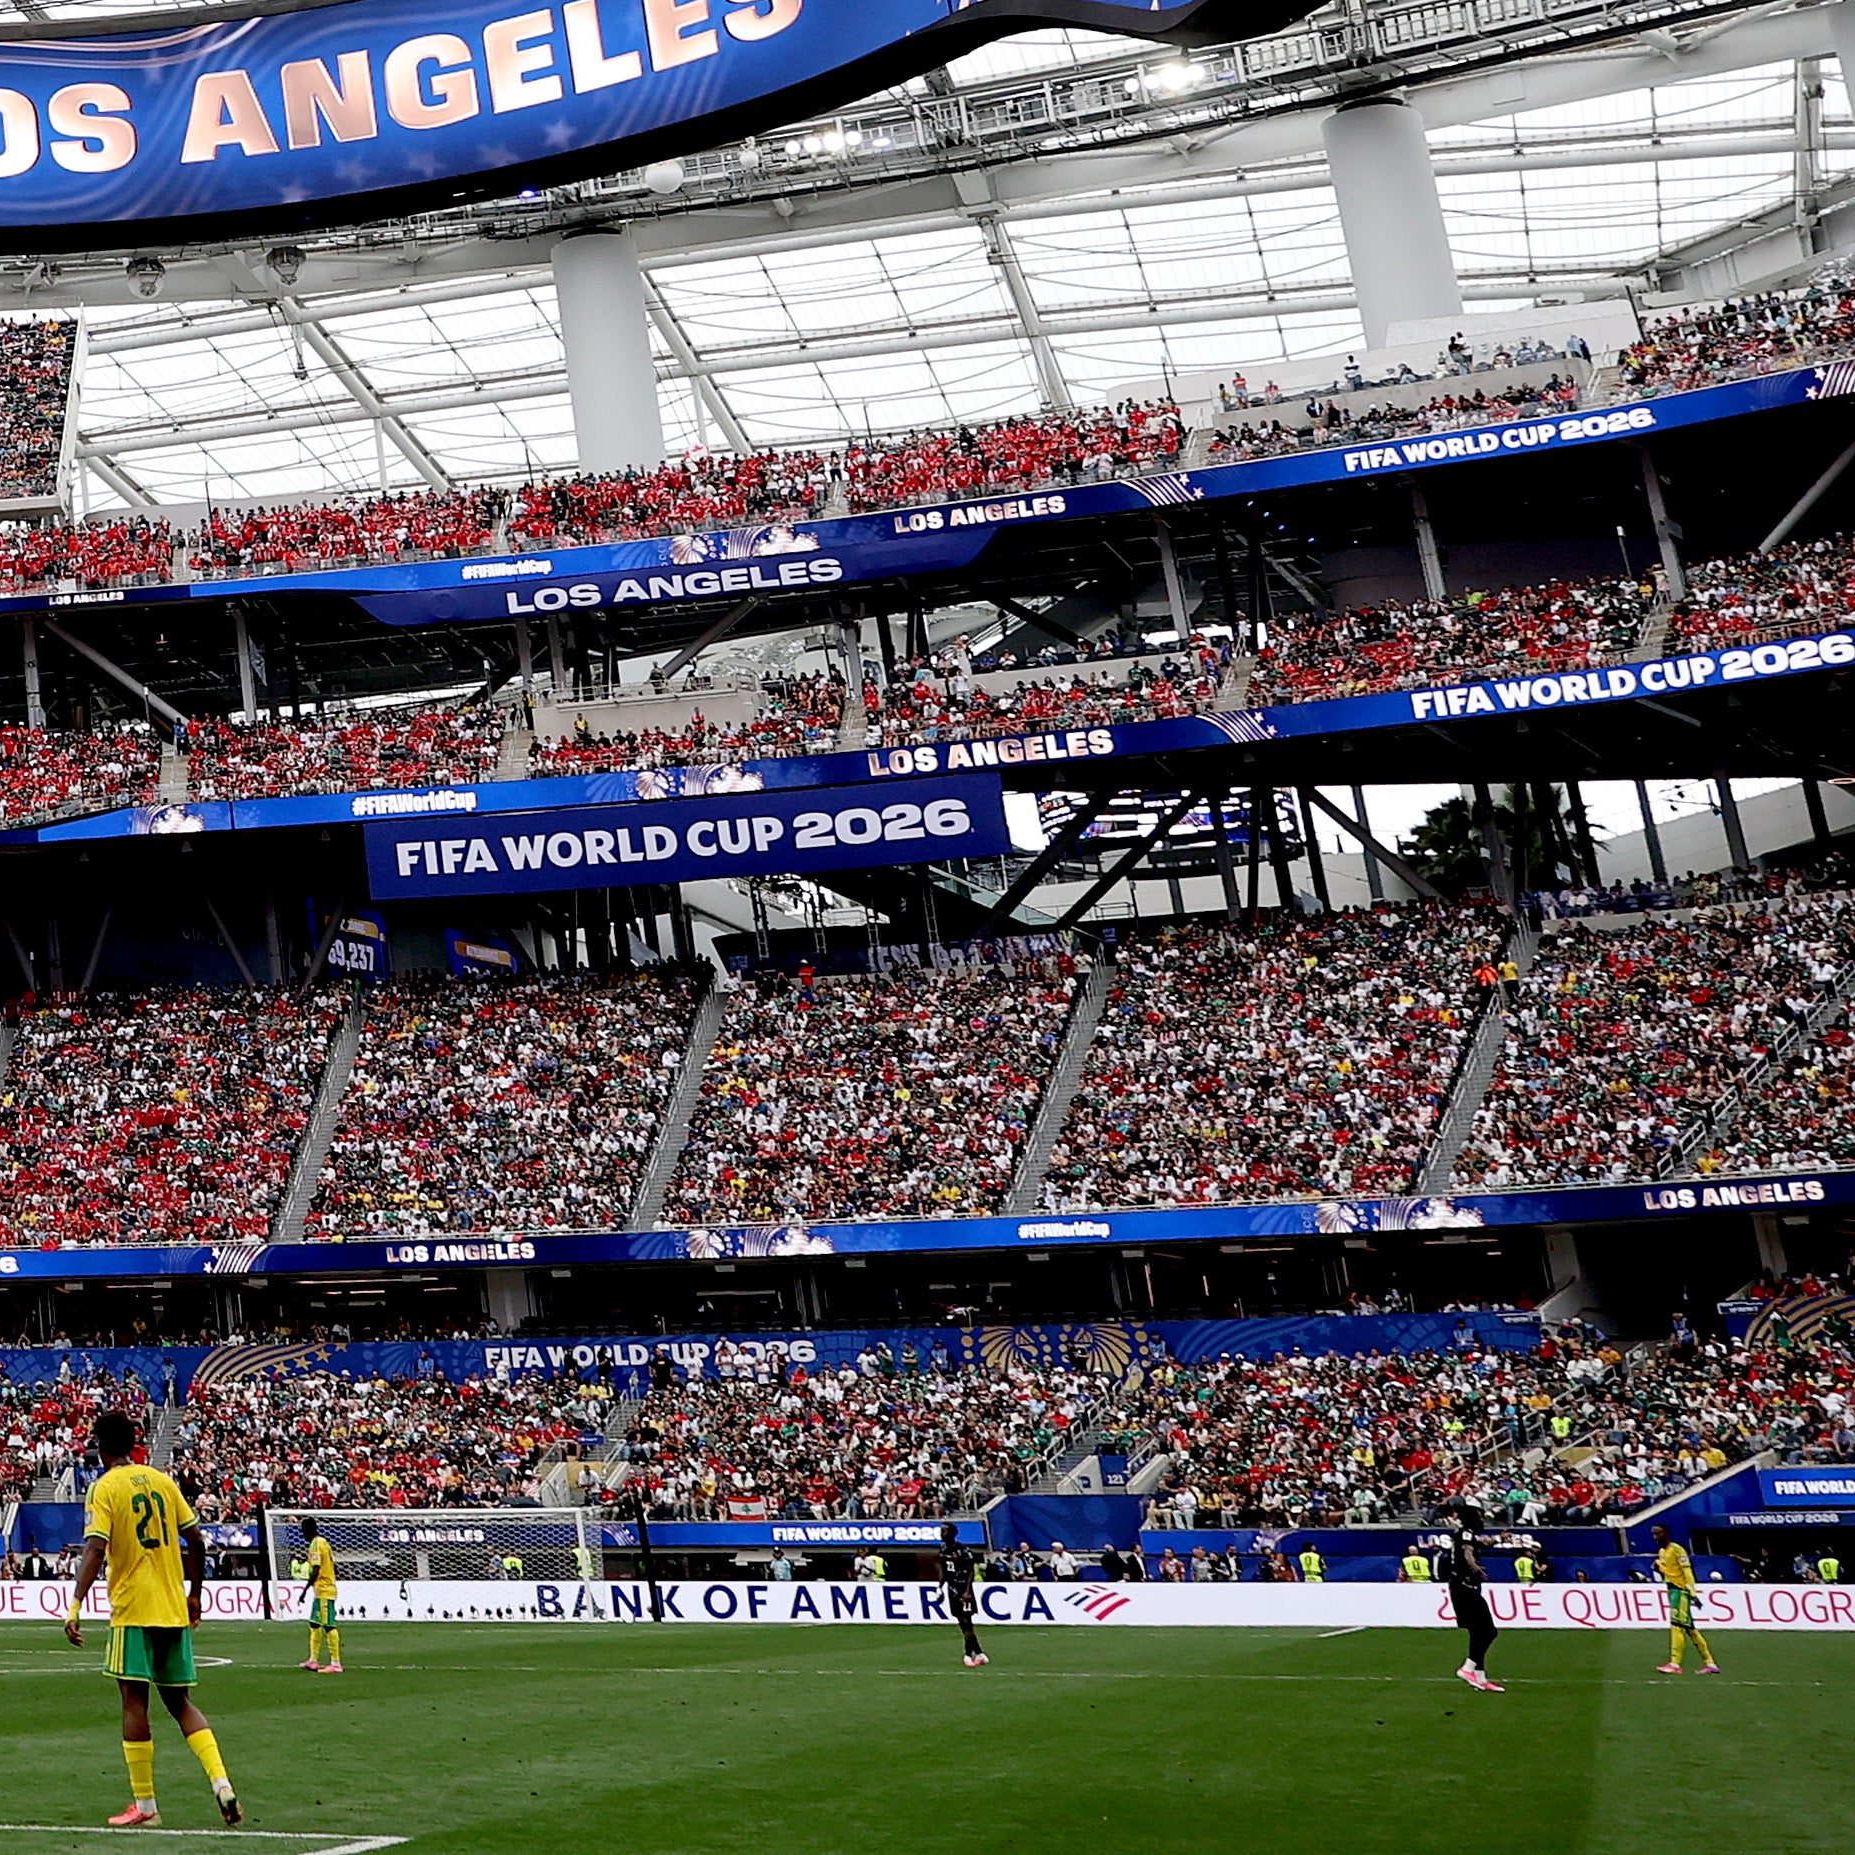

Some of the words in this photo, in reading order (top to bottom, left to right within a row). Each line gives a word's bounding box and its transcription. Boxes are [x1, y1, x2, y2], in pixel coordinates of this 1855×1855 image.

[1345, 448, 1402, 471] FIFA
[1402, 433, 1499, 462] WORLD
[1502, 424, 1556, 448] CUP
[1559, 408, 1654, 440] 2026
[895, 511, 943, 533] LOS
[950, 496, 1065, 526] ANGELES
[49, 595, 71, 605] LOS
[73, 592, 124, 603] ANGELES
[507, 584, 601, 613] LOS
[614, 559, 842, 602] ANGELES
[1411, 686, 1494, 718] FIFA
[1494, 670, 1636, 710] WORLD
[1641, 657, 1715, 690] CUP
[1720, 635, 1855, 679] 2026
[868, 747, 938, 776] LOS
[948, 729, 1113, 769] ANGELES
[352, 790, 476, 815] #FIFAWorldCup
[396, 839, 498, 876] FIFA
[502, 826, 677, 870] WORLD
[687, 817, 783, 856] CUP
[793, 799, 970, 848] 2026
[1644, 1189, 1696, 1209] LOS
[1703, 1181, 1824, 1206] ANGELES
[387, 1246, 429, 1262] LOS
[1107, 1474, 1125, 1485] 121
[1774, 1481, 1804, 1495] FIFA
[132, 1490, 169, 1550] 21
[773, 1527, 807, 1542] FIFA
[806, 1527, 860, 1542] WORLD
[861, 1527, 893, 1542] CUP
[703, 1584, 769, 1620] OF
[790, 1584, 1055, 1622] AMERCA
